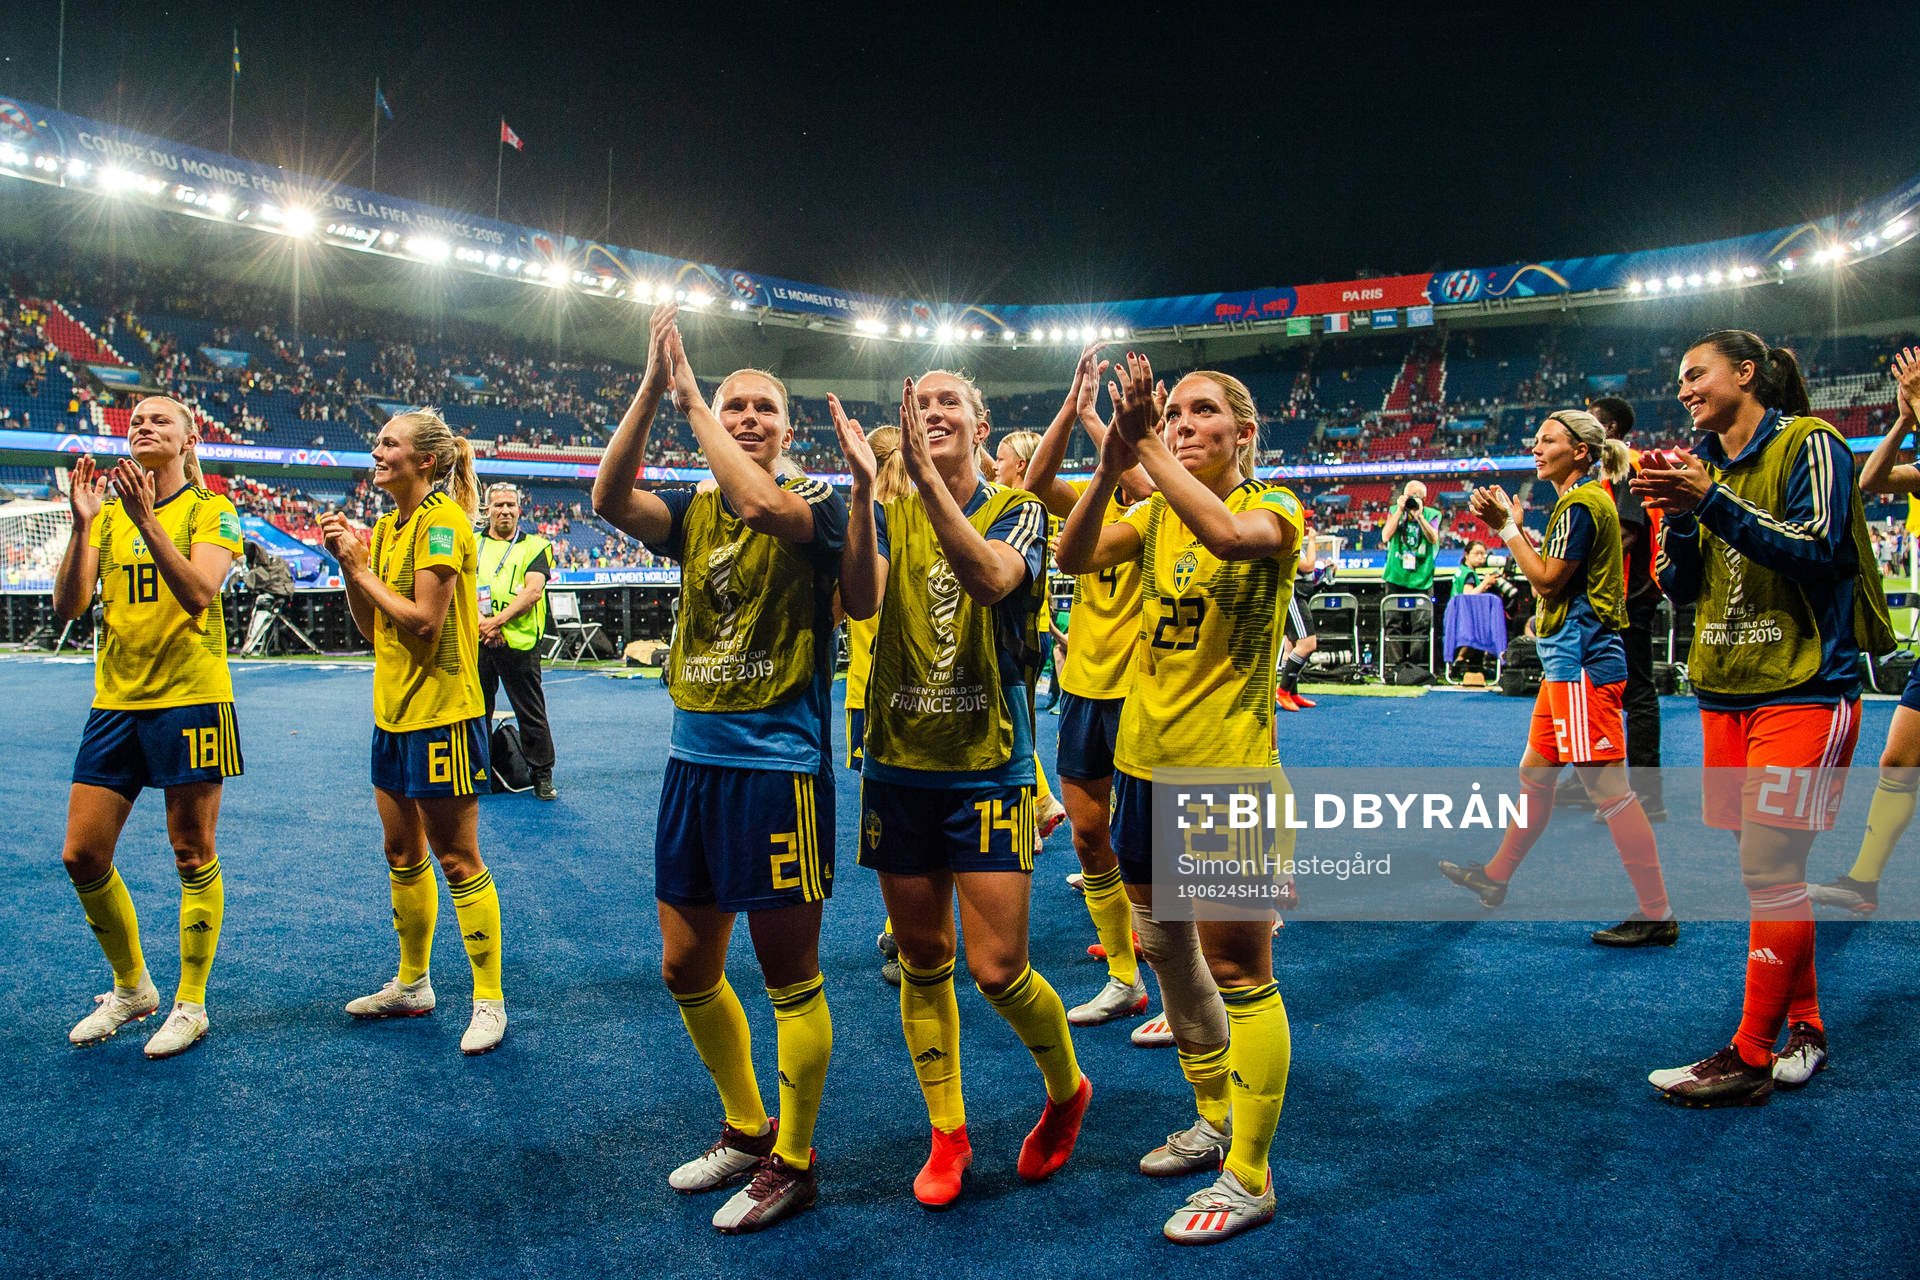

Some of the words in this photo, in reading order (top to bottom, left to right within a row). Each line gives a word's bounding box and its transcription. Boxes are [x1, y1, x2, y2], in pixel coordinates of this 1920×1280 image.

[78, 131, 151, 163] COUPE
[150, 149, 179, 172] DU
[180, 157, 250, 188] MONDE
[333, 195, 357, 213] DE
[357, 199, 380, 218] LA
[772, 287, 788, 300] LE
[788, 290, 834, 308] MOMENT
[833, 297, 849, 310] DE
[1342, 288, 1383, 302] PARIS
[122, 563, 159, 604] 18
[1151, 596, 1205, 650] 23
[1734, 621, 1758, 630] WORLD
[1760, 619, 1776, 628] CUP
[1700, 630, 1746, 646] FRANCE
[1748, 627, 1783, 644] 2019
[718, 654, 746, 664] WORLD
[749, 650, 767, 660] CUP
[735, 660, 774, 680] 2019
[933, 670, 951, 681] FIFA
[900, 685, 936, 695] WOMEN'S
[938, 685, 967, 695] WORLD
[969, 685, 983, 694] CUP
[890, 693, 951, 714] FRANCE
[956, 693, 988, 713] 2019
[183, 727, 219, 769] 18
[428, 741, 452, 783] 6
[1757, 765, 1812, 818] 21
[974, 799, 1019, 854] 14
[770, 832, 801, 890] 2
